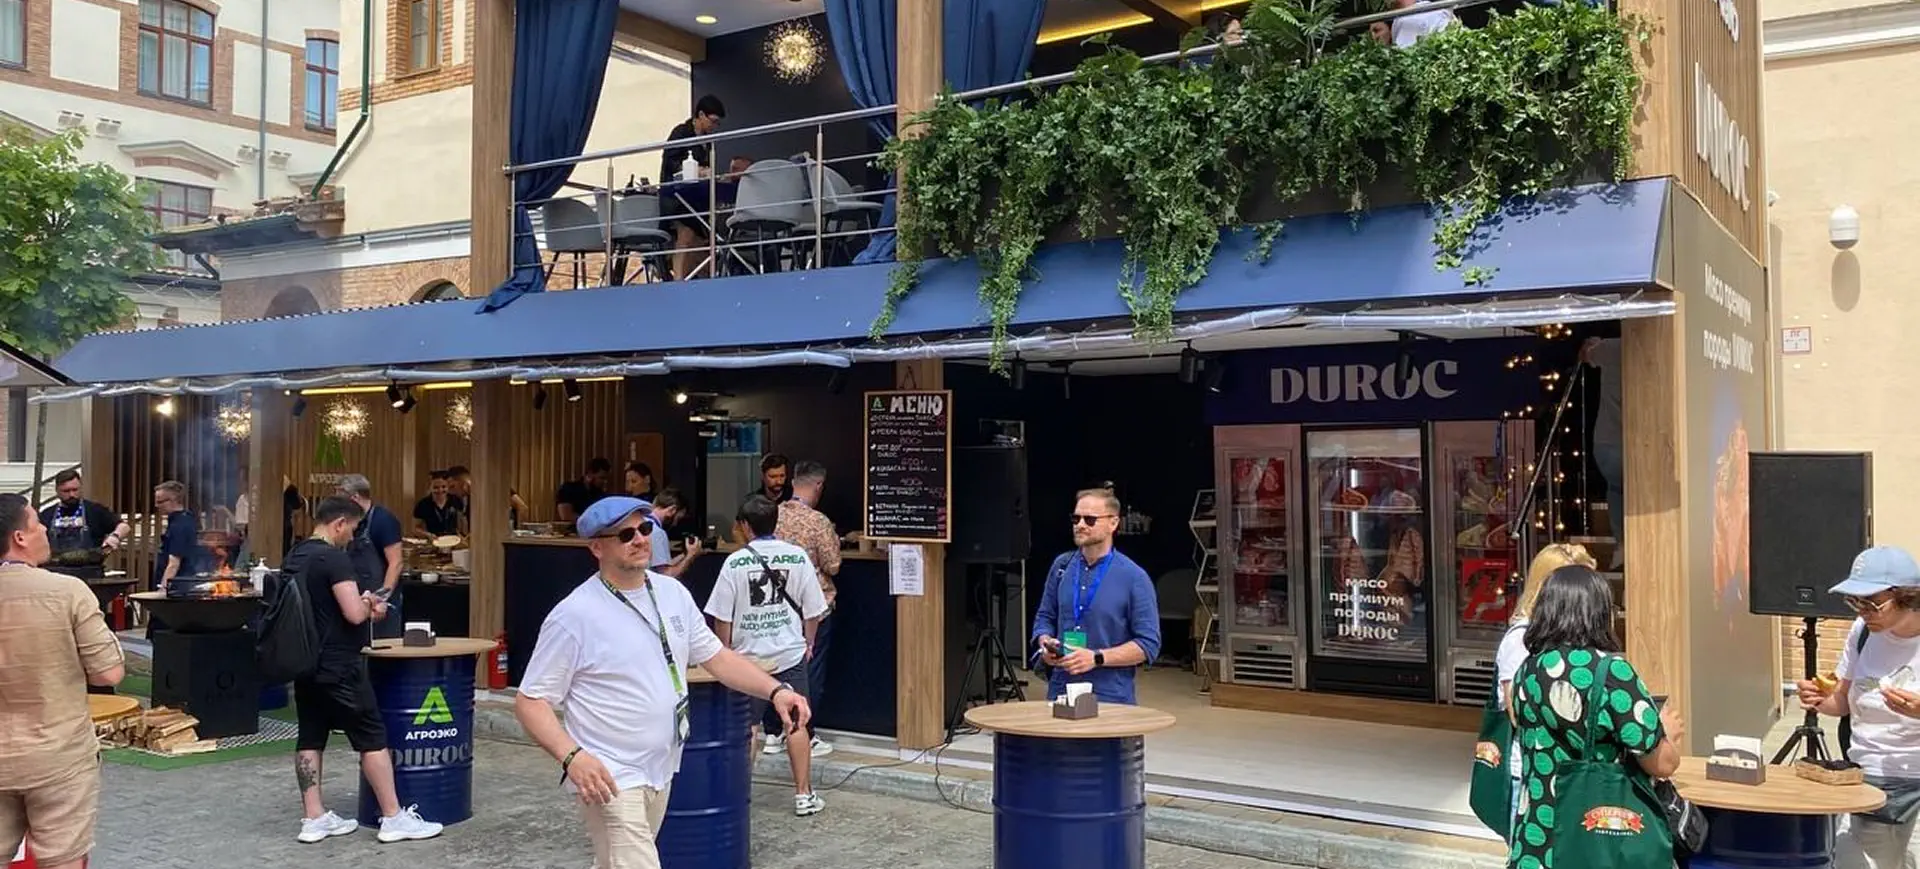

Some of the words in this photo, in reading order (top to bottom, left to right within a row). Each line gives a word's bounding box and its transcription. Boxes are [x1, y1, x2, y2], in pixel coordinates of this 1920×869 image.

[1271, 359, 1458, 404] DUROC
[890, 395, 943, 416] МЕНЮ
[771, 554, 806, 565] AREA
[1345, 578, 1388, 589] мясо
[1329, 592, 1404, 607] премиум
[405, 728, 459, 741] АГРОЭКО
